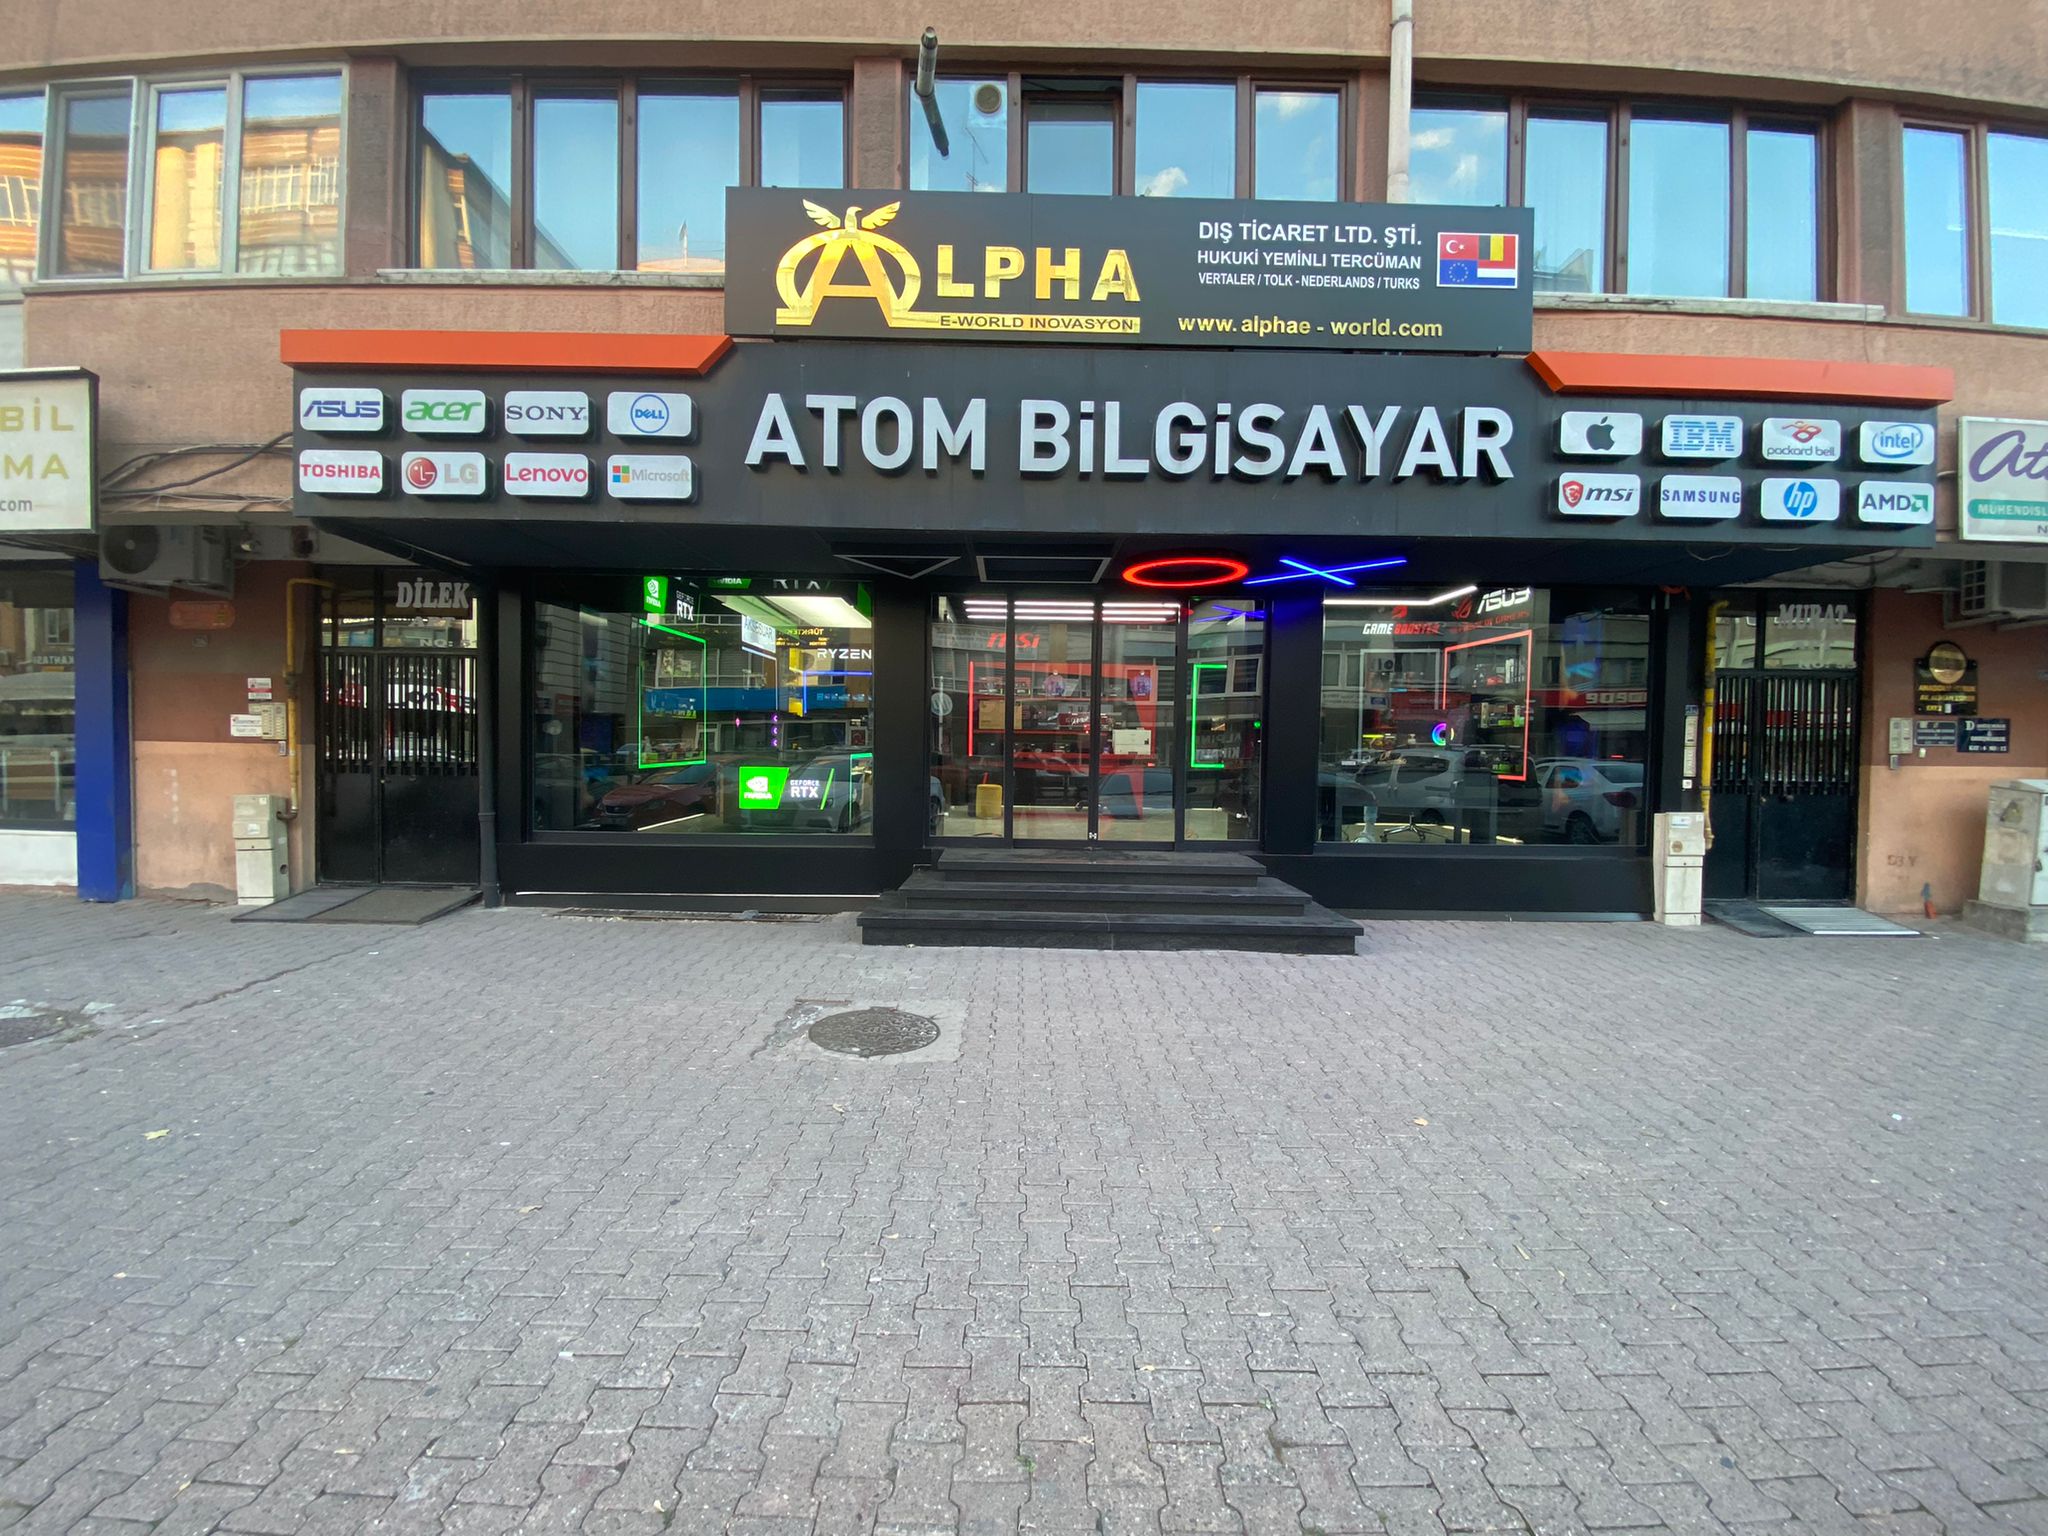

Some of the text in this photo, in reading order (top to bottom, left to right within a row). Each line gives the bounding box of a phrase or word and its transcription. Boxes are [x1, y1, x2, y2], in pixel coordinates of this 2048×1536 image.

[1199, 218, 1422, 248] DIŞ TİCARET LTD. ŞTİ.
[1197, 248, 1259, 266] HUKUKİ
[1331, 251, 1422, 270] TERCÜMAN
[1198, 272, 1255, 287] VERTALER
[1257, 274, 1262, 286] /
[1264, 273, 1293, 287] TOLK
[1301, 274, 1375, 289] NEDERLANDS
[1377, 276, 1382, 289] /
[1384, 276, 1420, 290] TURKS
[940, 315, 1134, 331] E-WORLD INOVASYON
[303, 400, 381, 418] ASUS
[405, 401, 482, 422] acer
[506, 405, 587, 421] SONY
[634, 408, 665, 420] DELL
[744, 393, 987, 471] ATOM
[1669, 420, 1736, 452] IBM
[1880, 431, 1916, 449] intel
[1766, 446, 1835, 457] packard bell
[301, 463, 381, 479] TOSHIBA
[444, 463, 479, 485] LG
[506, 463, 587, 482] Lenovo
[631, 469, 690, 483] Microsoft
[1585, 487, 1634, 502] msi
[1662, 489, 1741, 504] SAMSUNG
[1786, 482, 1816, 517] hp
[1861, 493, 1912, 512] AMD
[395, 577, 471, 609] DİLEK
[1477, 587, 1534, 614] ASUS
[676, 599, 695, 621] RTX
[1779, 603, 1849, 629] MURAT
[1362, 623, 1394, 635] GAME
[816, 648, 872, 660] RYZEN
[790, 786, 819, 799] RTX
